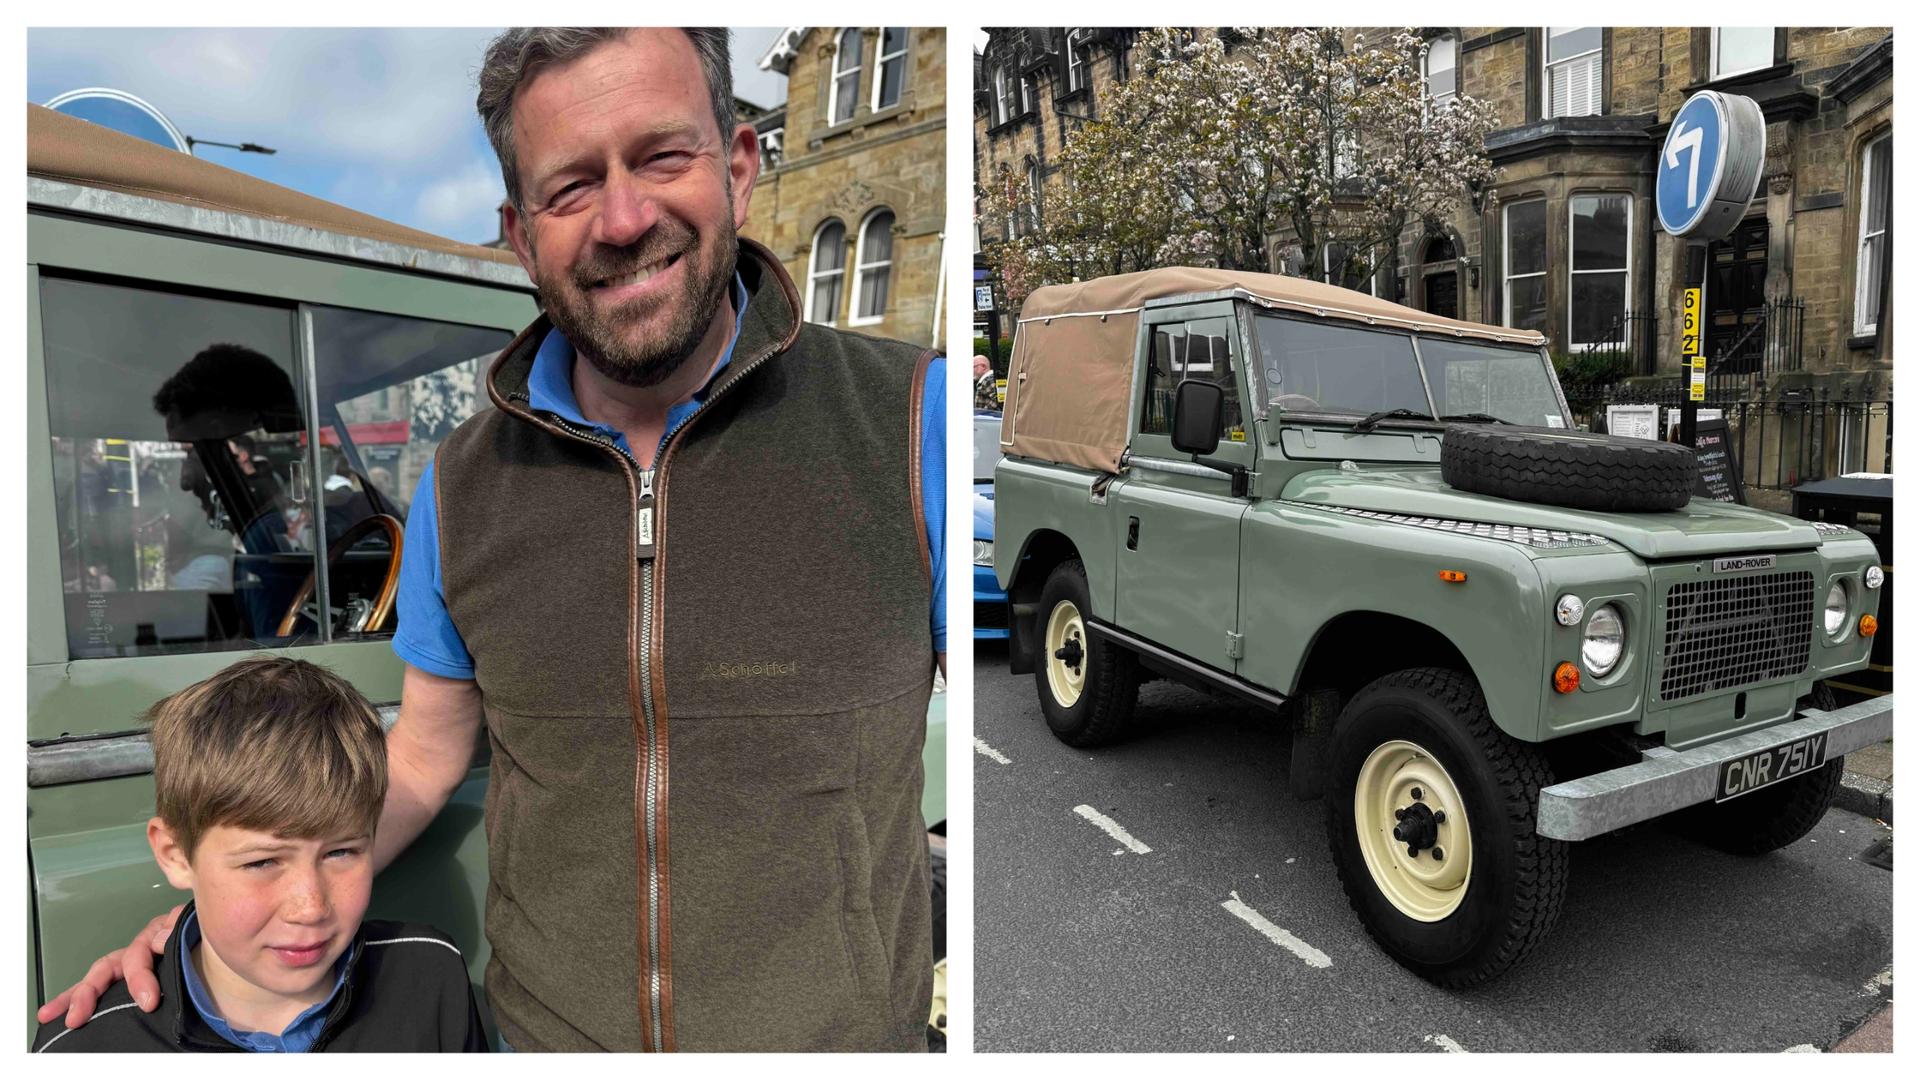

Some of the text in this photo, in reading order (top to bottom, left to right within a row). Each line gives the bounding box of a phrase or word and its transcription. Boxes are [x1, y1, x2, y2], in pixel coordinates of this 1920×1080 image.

[1683, 291, 1694, 352] 662
[1721, 558, 1771, 570] LAND-ROVER
[1725, 735, 1824, 796] CNR 751Y
